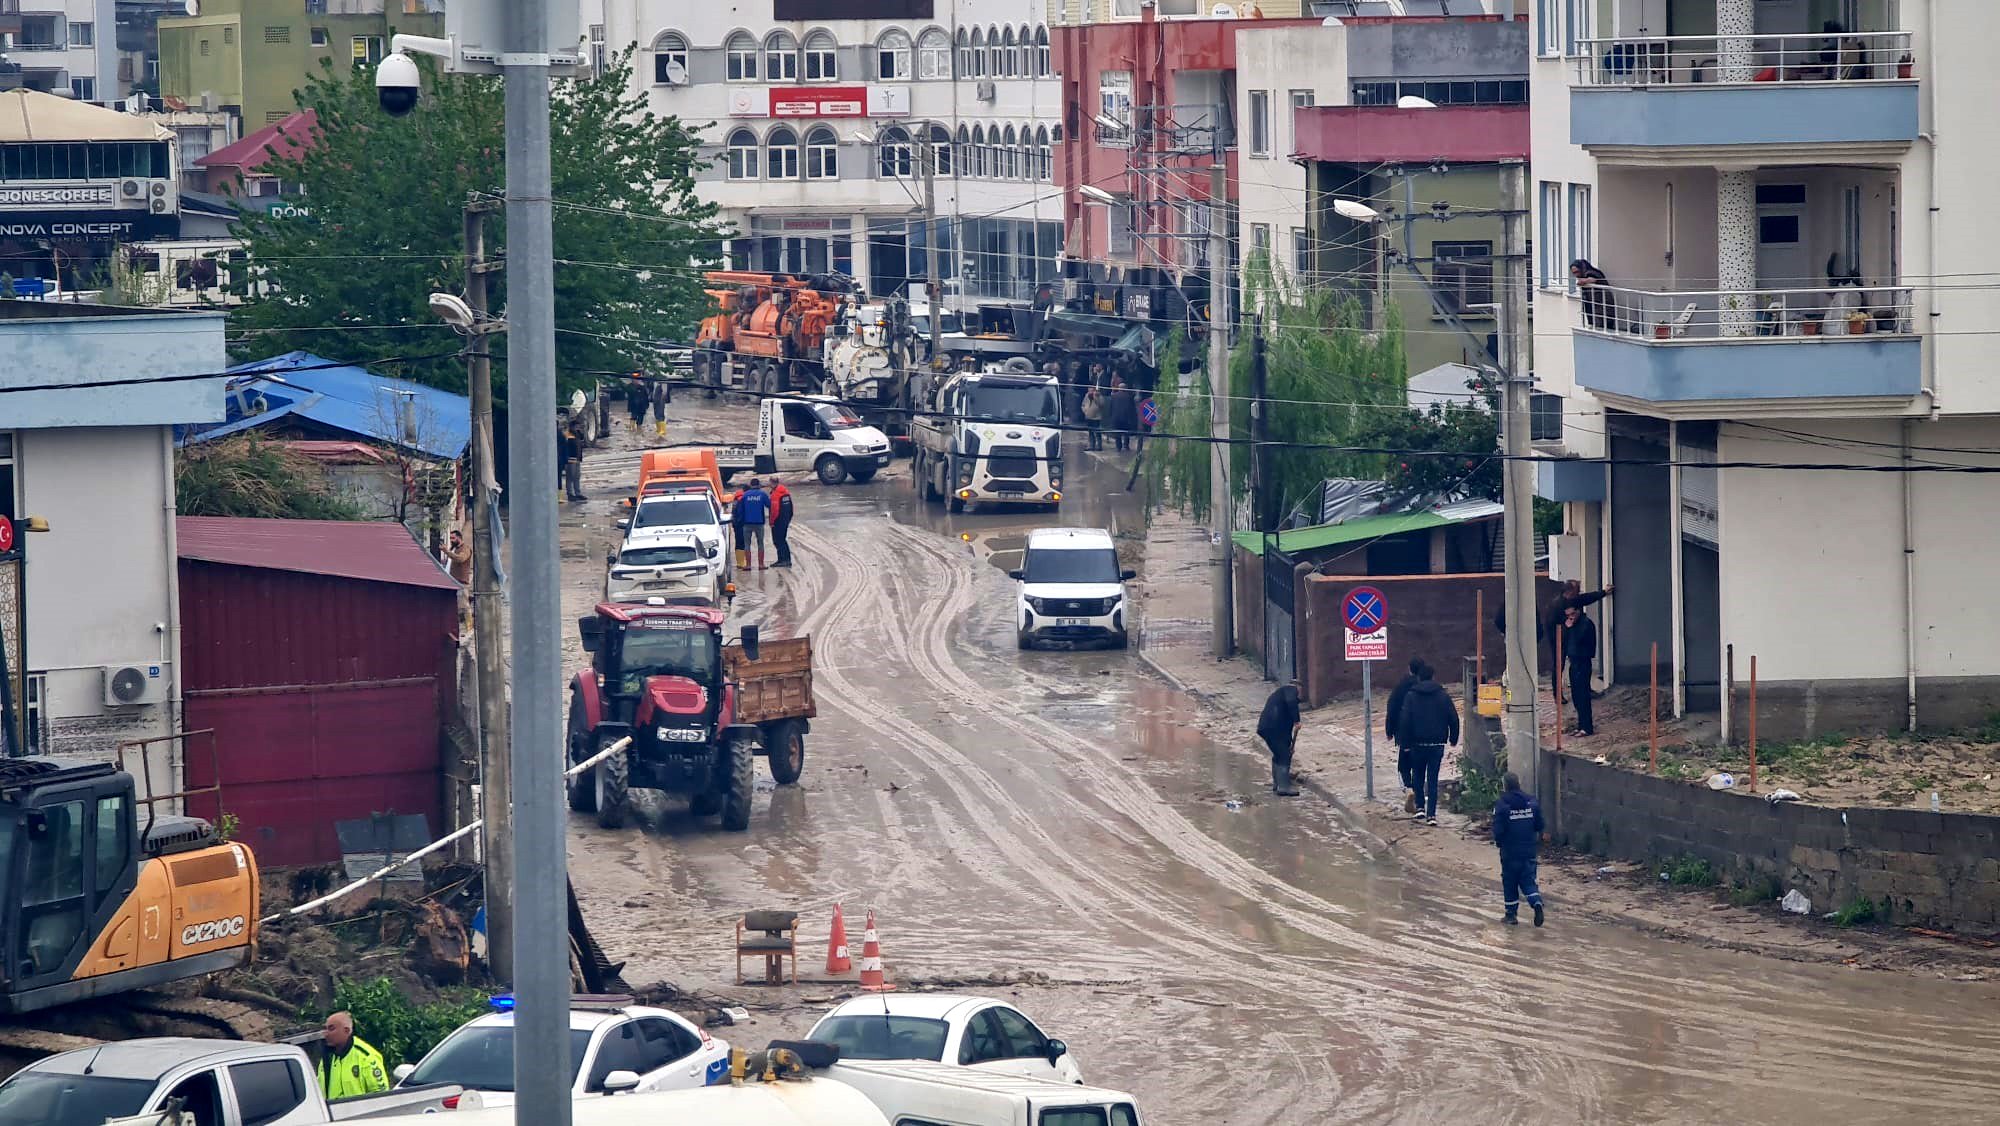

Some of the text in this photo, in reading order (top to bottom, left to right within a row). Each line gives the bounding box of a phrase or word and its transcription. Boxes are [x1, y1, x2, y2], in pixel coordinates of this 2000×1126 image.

[2, 189, 107, 201] JONES COFFEE
[1, 222, 133, 235] NOVA CONCEPT
[182, 916, 244, 945] CX210C
